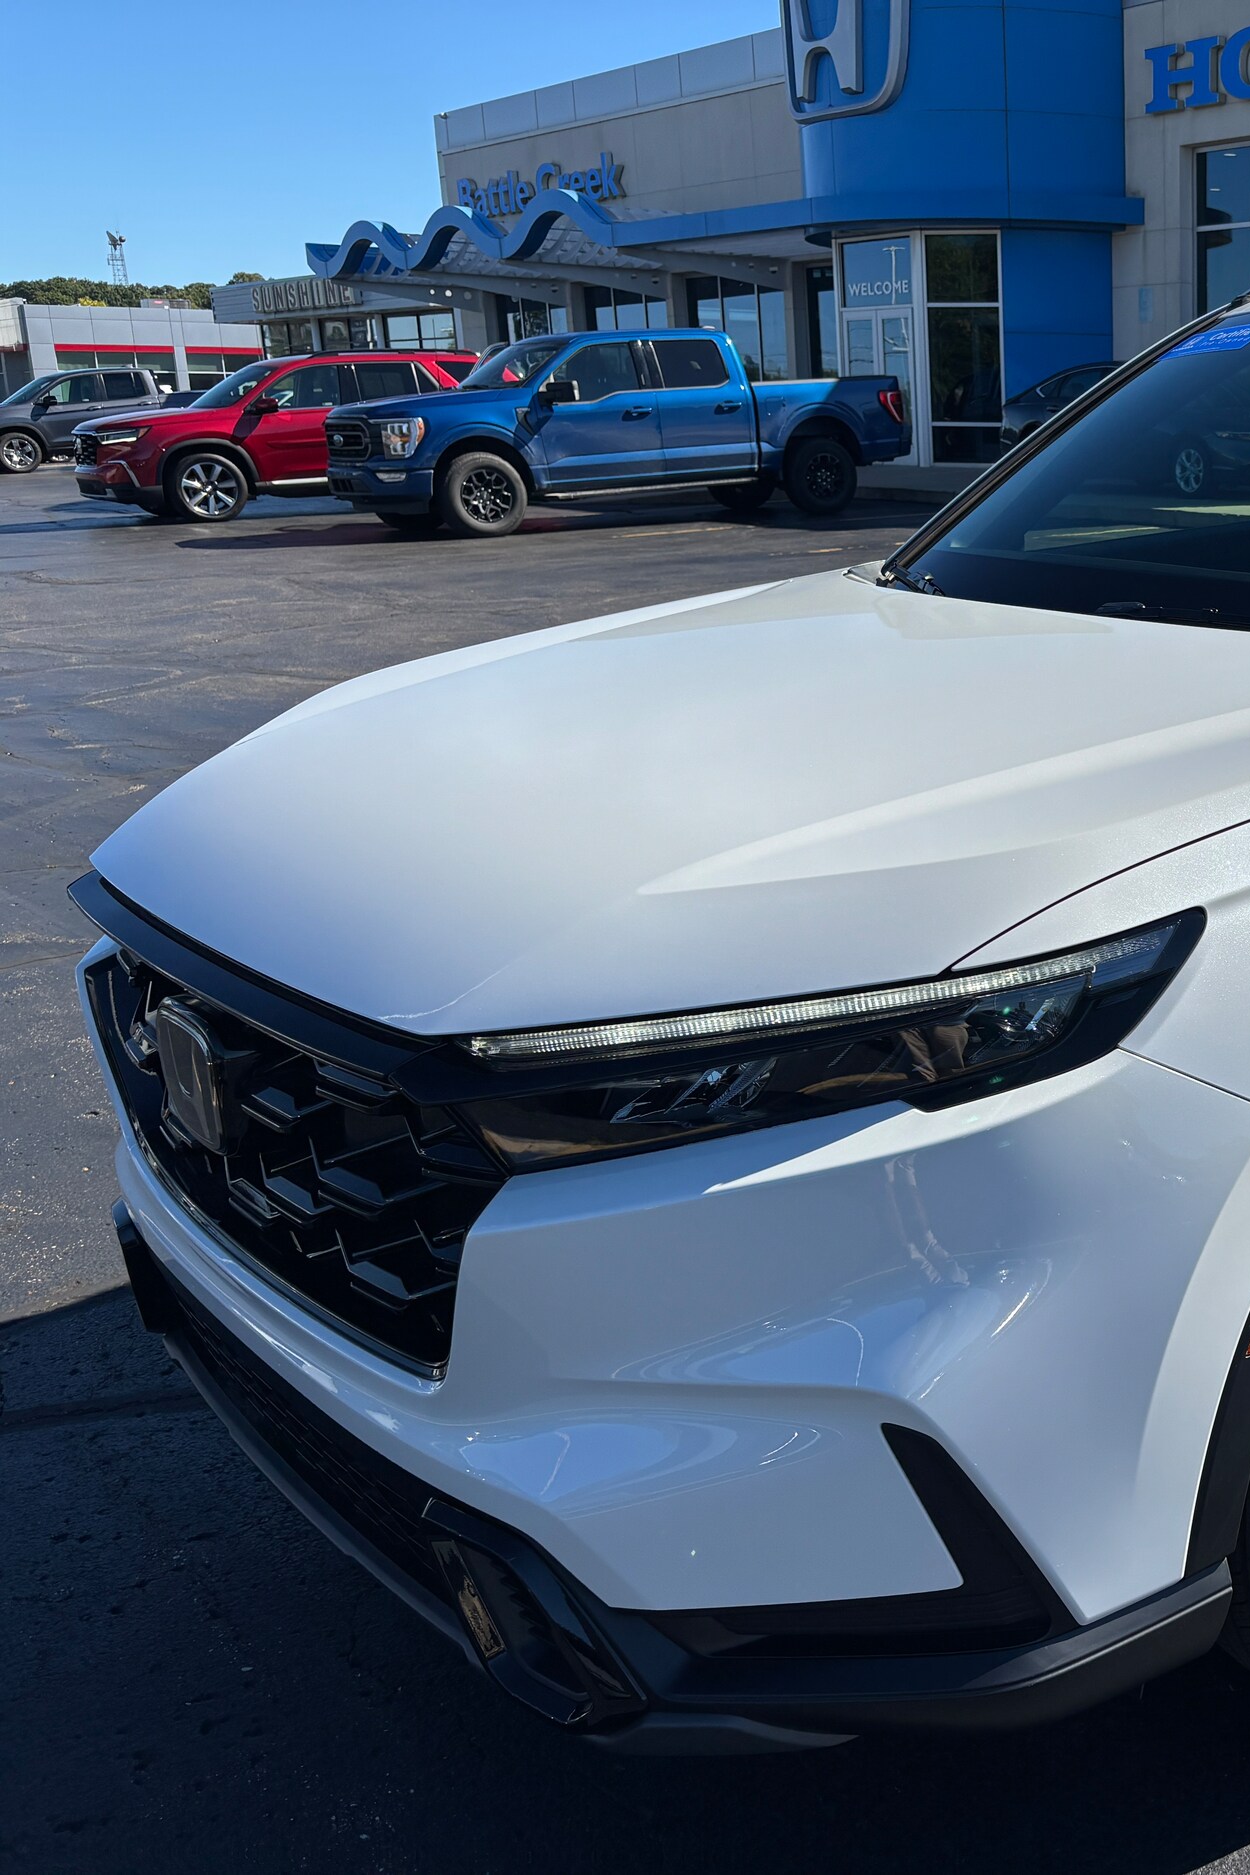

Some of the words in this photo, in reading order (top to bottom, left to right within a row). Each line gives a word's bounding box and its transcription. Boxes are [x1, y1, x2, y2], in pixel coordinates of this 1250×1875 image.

[456, 169, 534, 217] Battle
[535, 151, 624, 200] Creek
[251, 279, 355, 312] SUNSHINE
[848, 280, 909, 297] WELCOME
